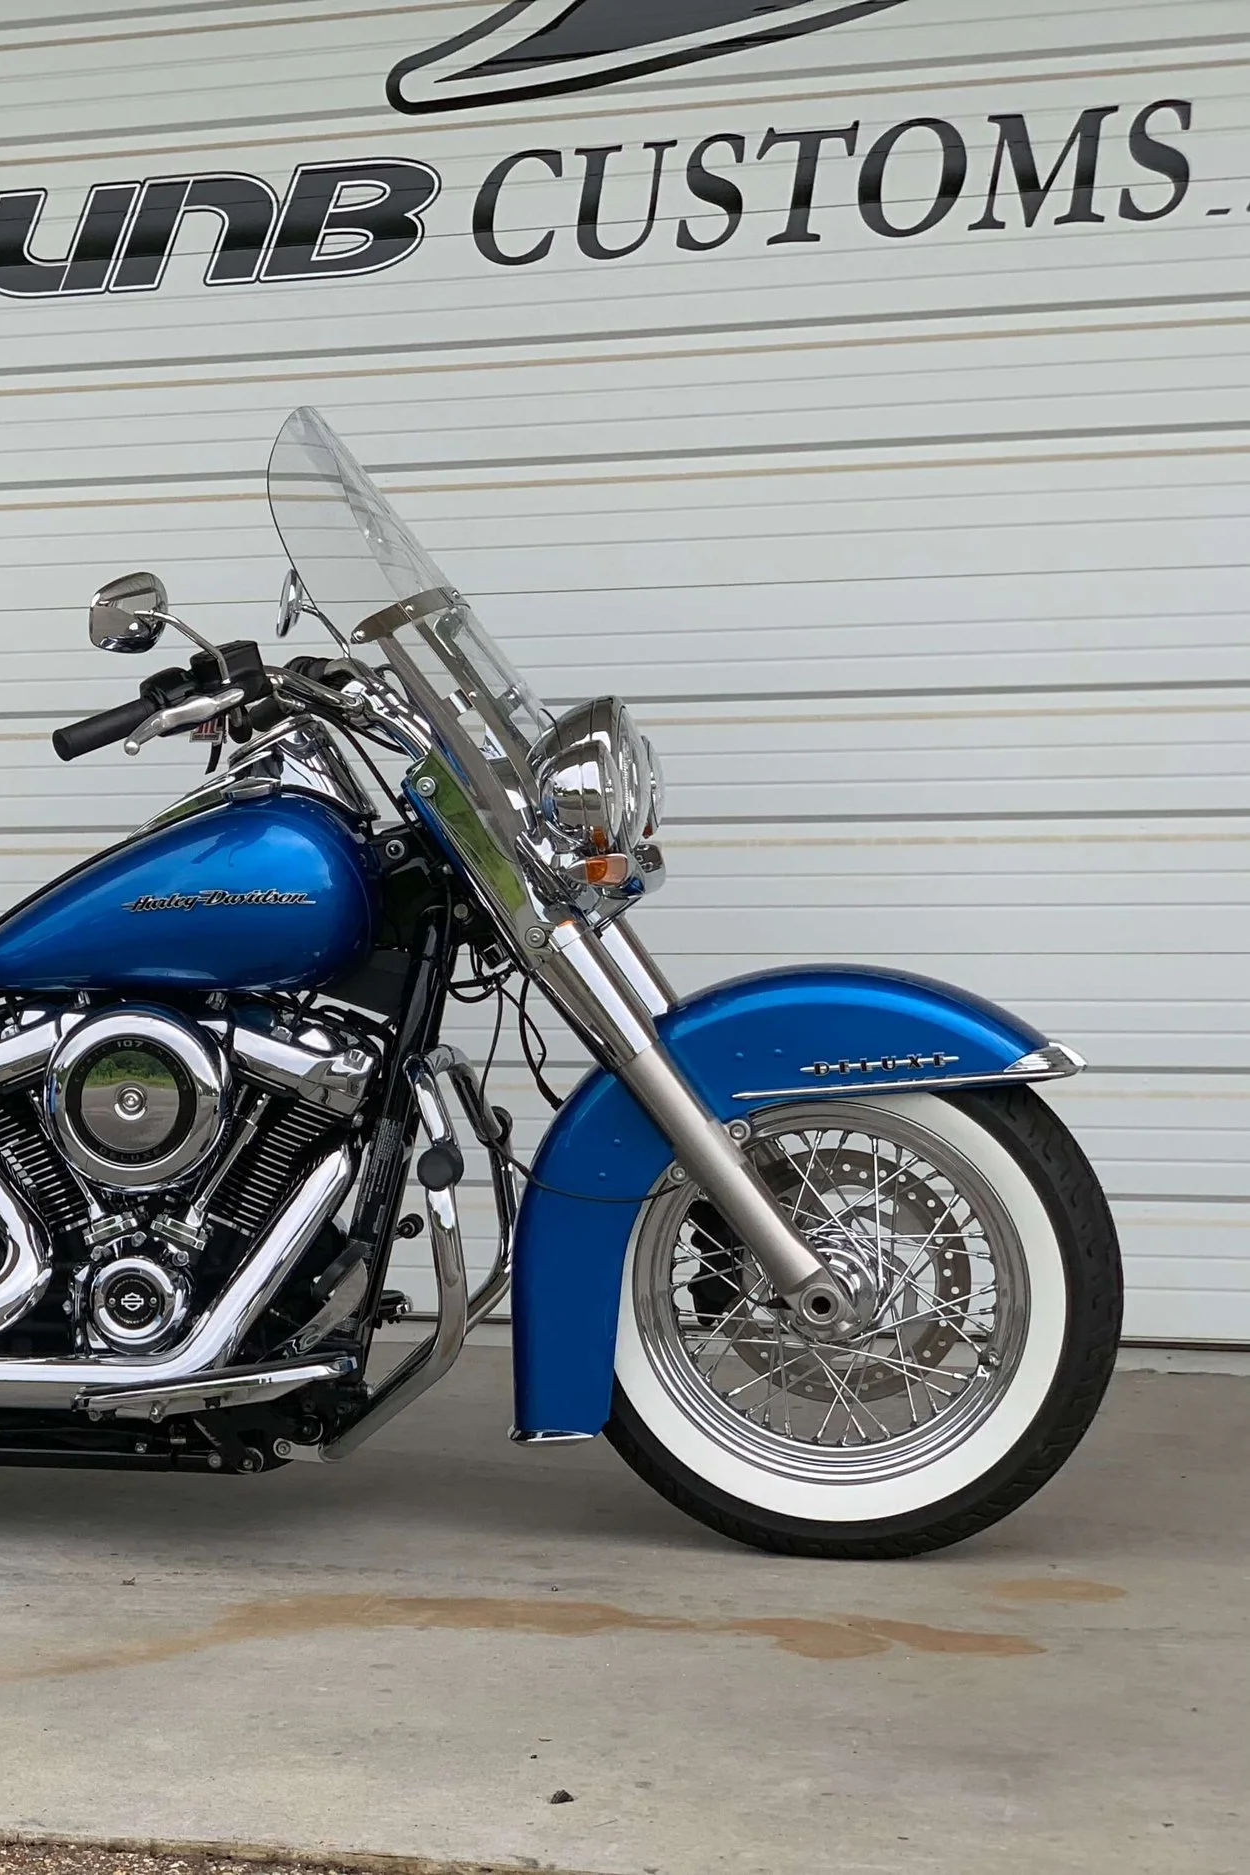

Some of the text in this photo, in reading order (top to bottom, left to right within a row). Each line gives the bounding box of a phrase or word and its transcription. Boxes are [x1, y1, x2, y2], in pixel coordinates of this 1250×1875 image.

[472, 98, 1192, 266] CUSTOMS
[121, 888, 316, 912] Harley-Davidson
[116, 1039, 144, 1048] 107
[812, 1051, 948, 1077] DELUXE
